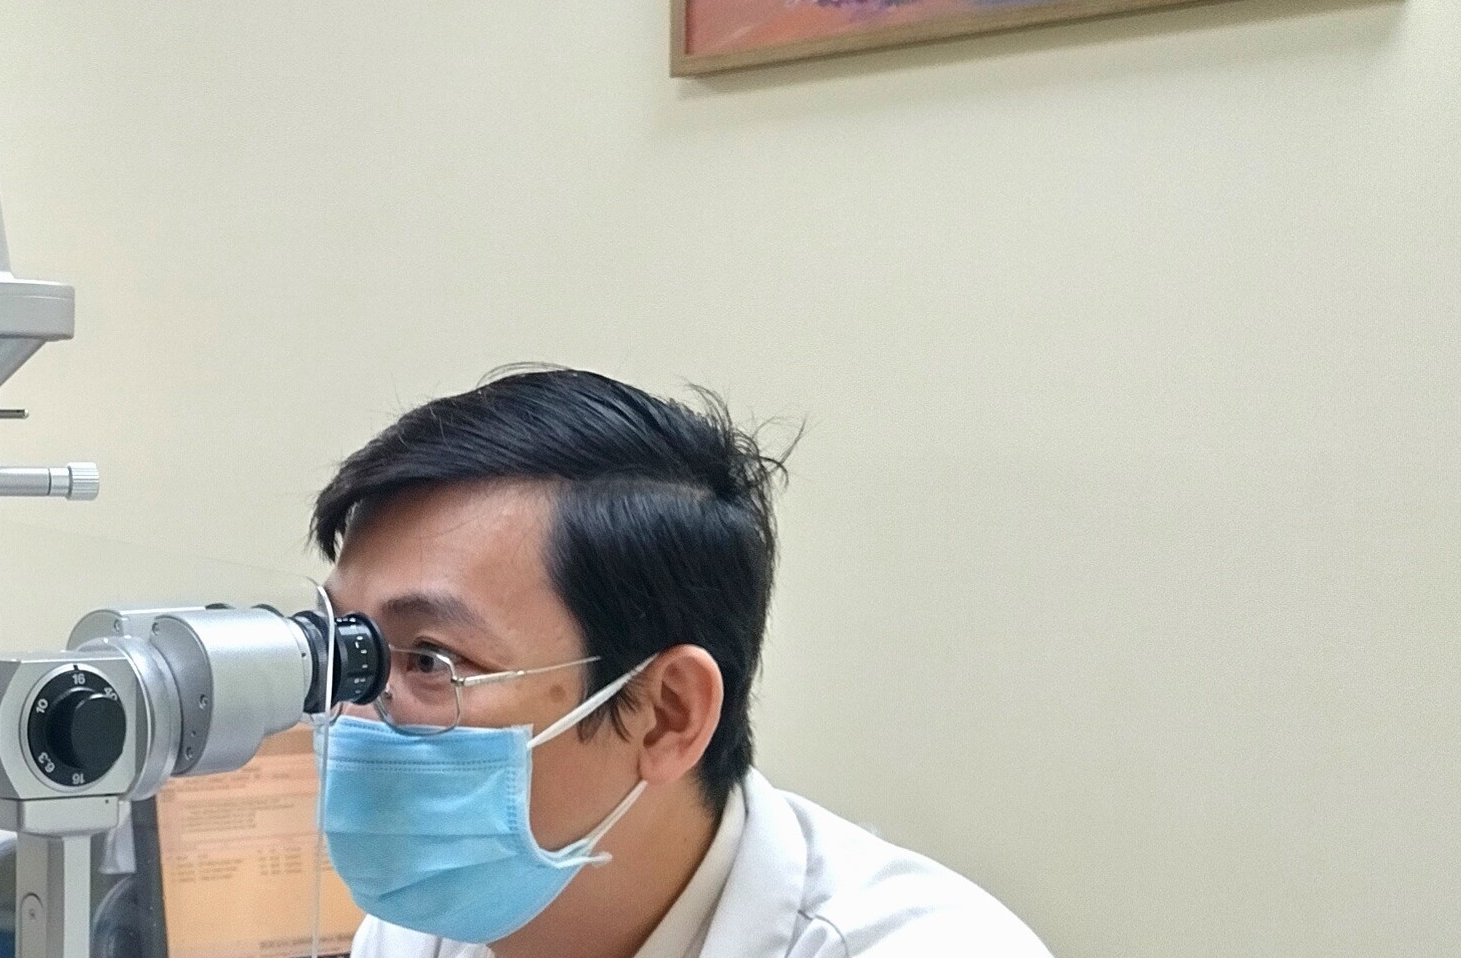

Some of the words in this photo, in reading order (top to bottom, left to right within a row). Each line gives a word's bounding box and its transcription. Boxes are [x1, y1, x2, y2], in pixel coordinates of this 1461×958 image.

[72, 673, 86, 685] 16
[36, 698, 49, 714] 10
[38, 752, 55, 773] 6.3
[72, 773, 85, 785] 16
